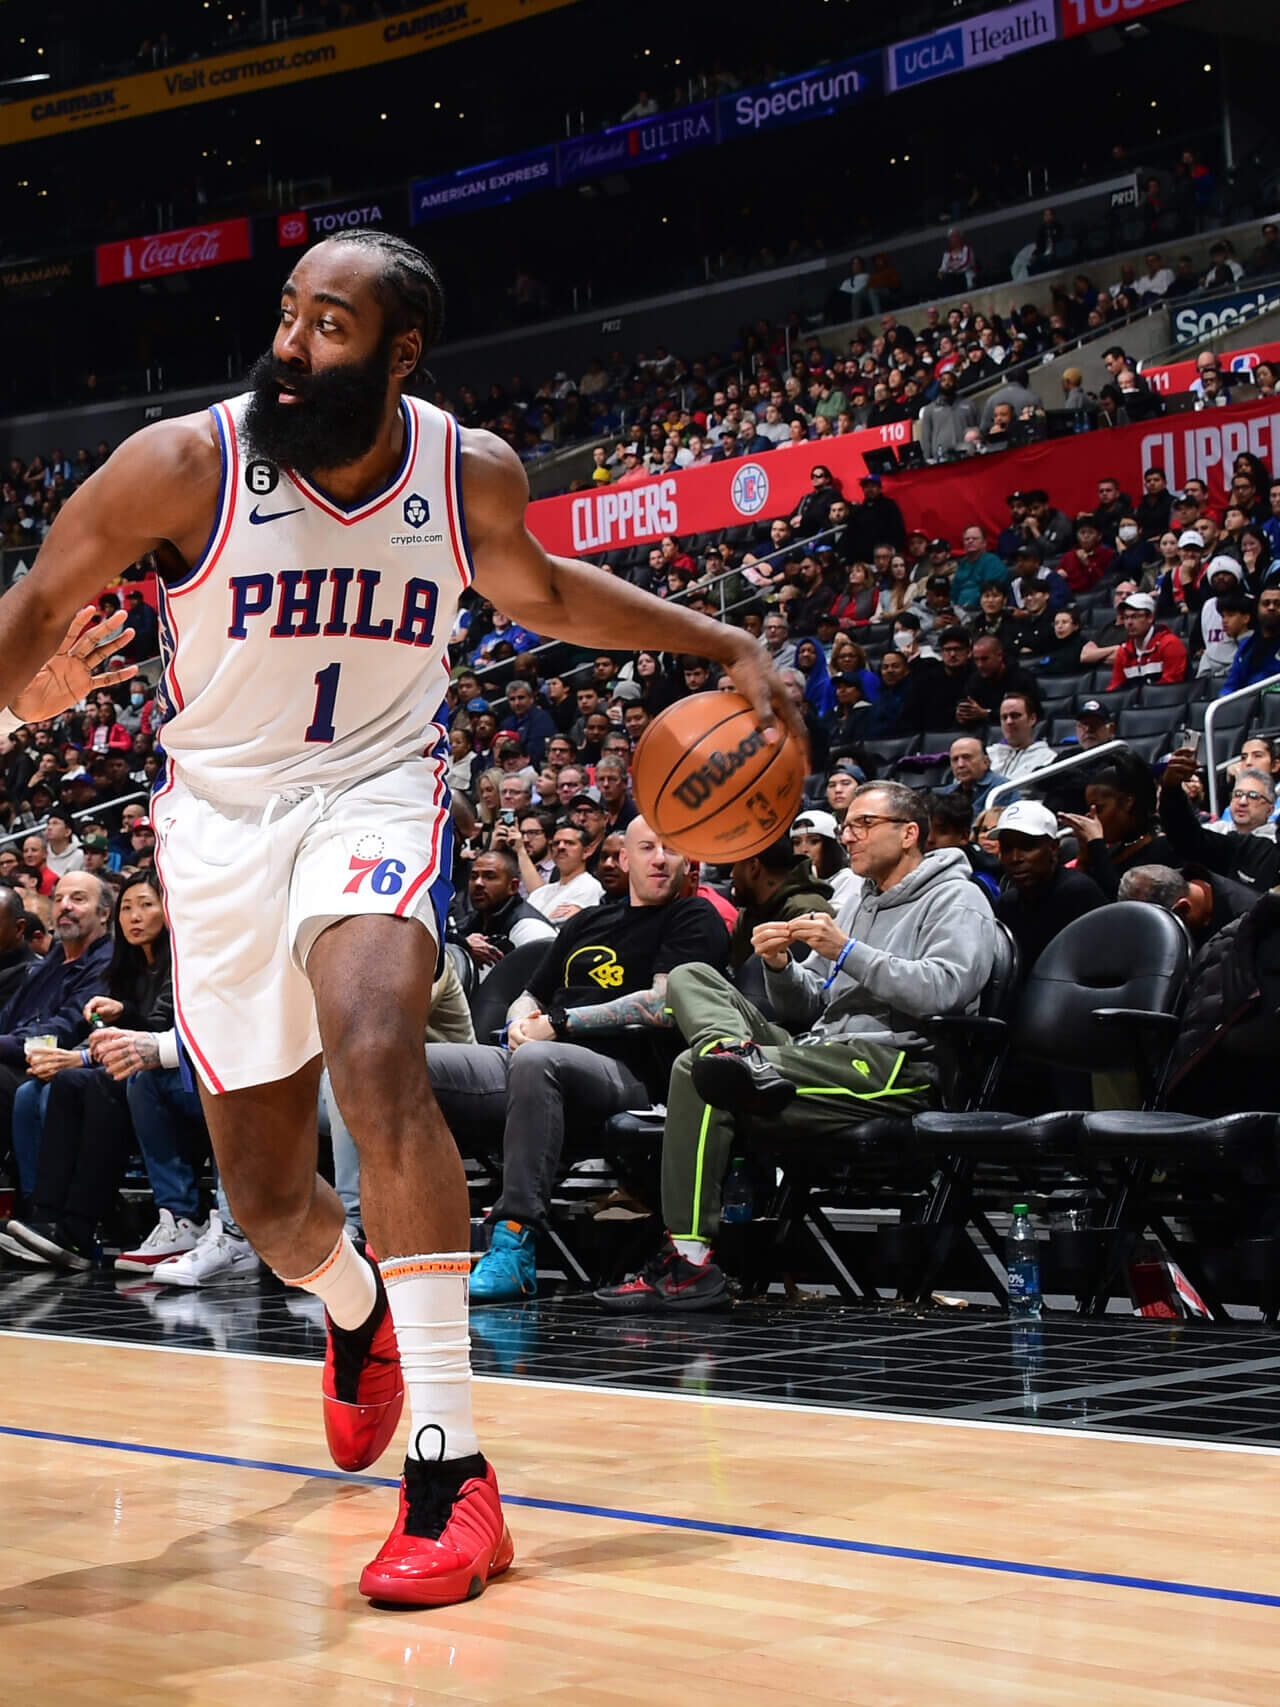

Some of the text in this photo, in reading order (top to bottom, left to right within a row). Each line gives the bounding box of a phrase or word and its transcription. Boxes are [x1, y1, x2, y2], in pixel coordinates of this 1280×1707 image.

[903, 40, 955, 75] UCLA
[970, 8, 1047, 56] Health
[164, 41, 337, 96] Visit carmax.com
[735, 71, 860, 127] Spectrum
[641, 115, 712, 151] ULTRA
[421, 162, 549, 209] AMERICAN EXPRESS
[312, 205, 384, 234] TOYOTA
[1176, 293, 1280, 346] Spect
[880, 423, 905, 443] 110
[1141, 415, 1280, 498] CLIPPE
[252, 466, 270, 489] 6
[391, 533, 443, 545] crypto.com
[572, 478, 678, 551] CLIPPERS
[228, 568, 439, 648] PHILA
[305, 662, 341, 743] 1
[343, 855, 406, 895] 76
